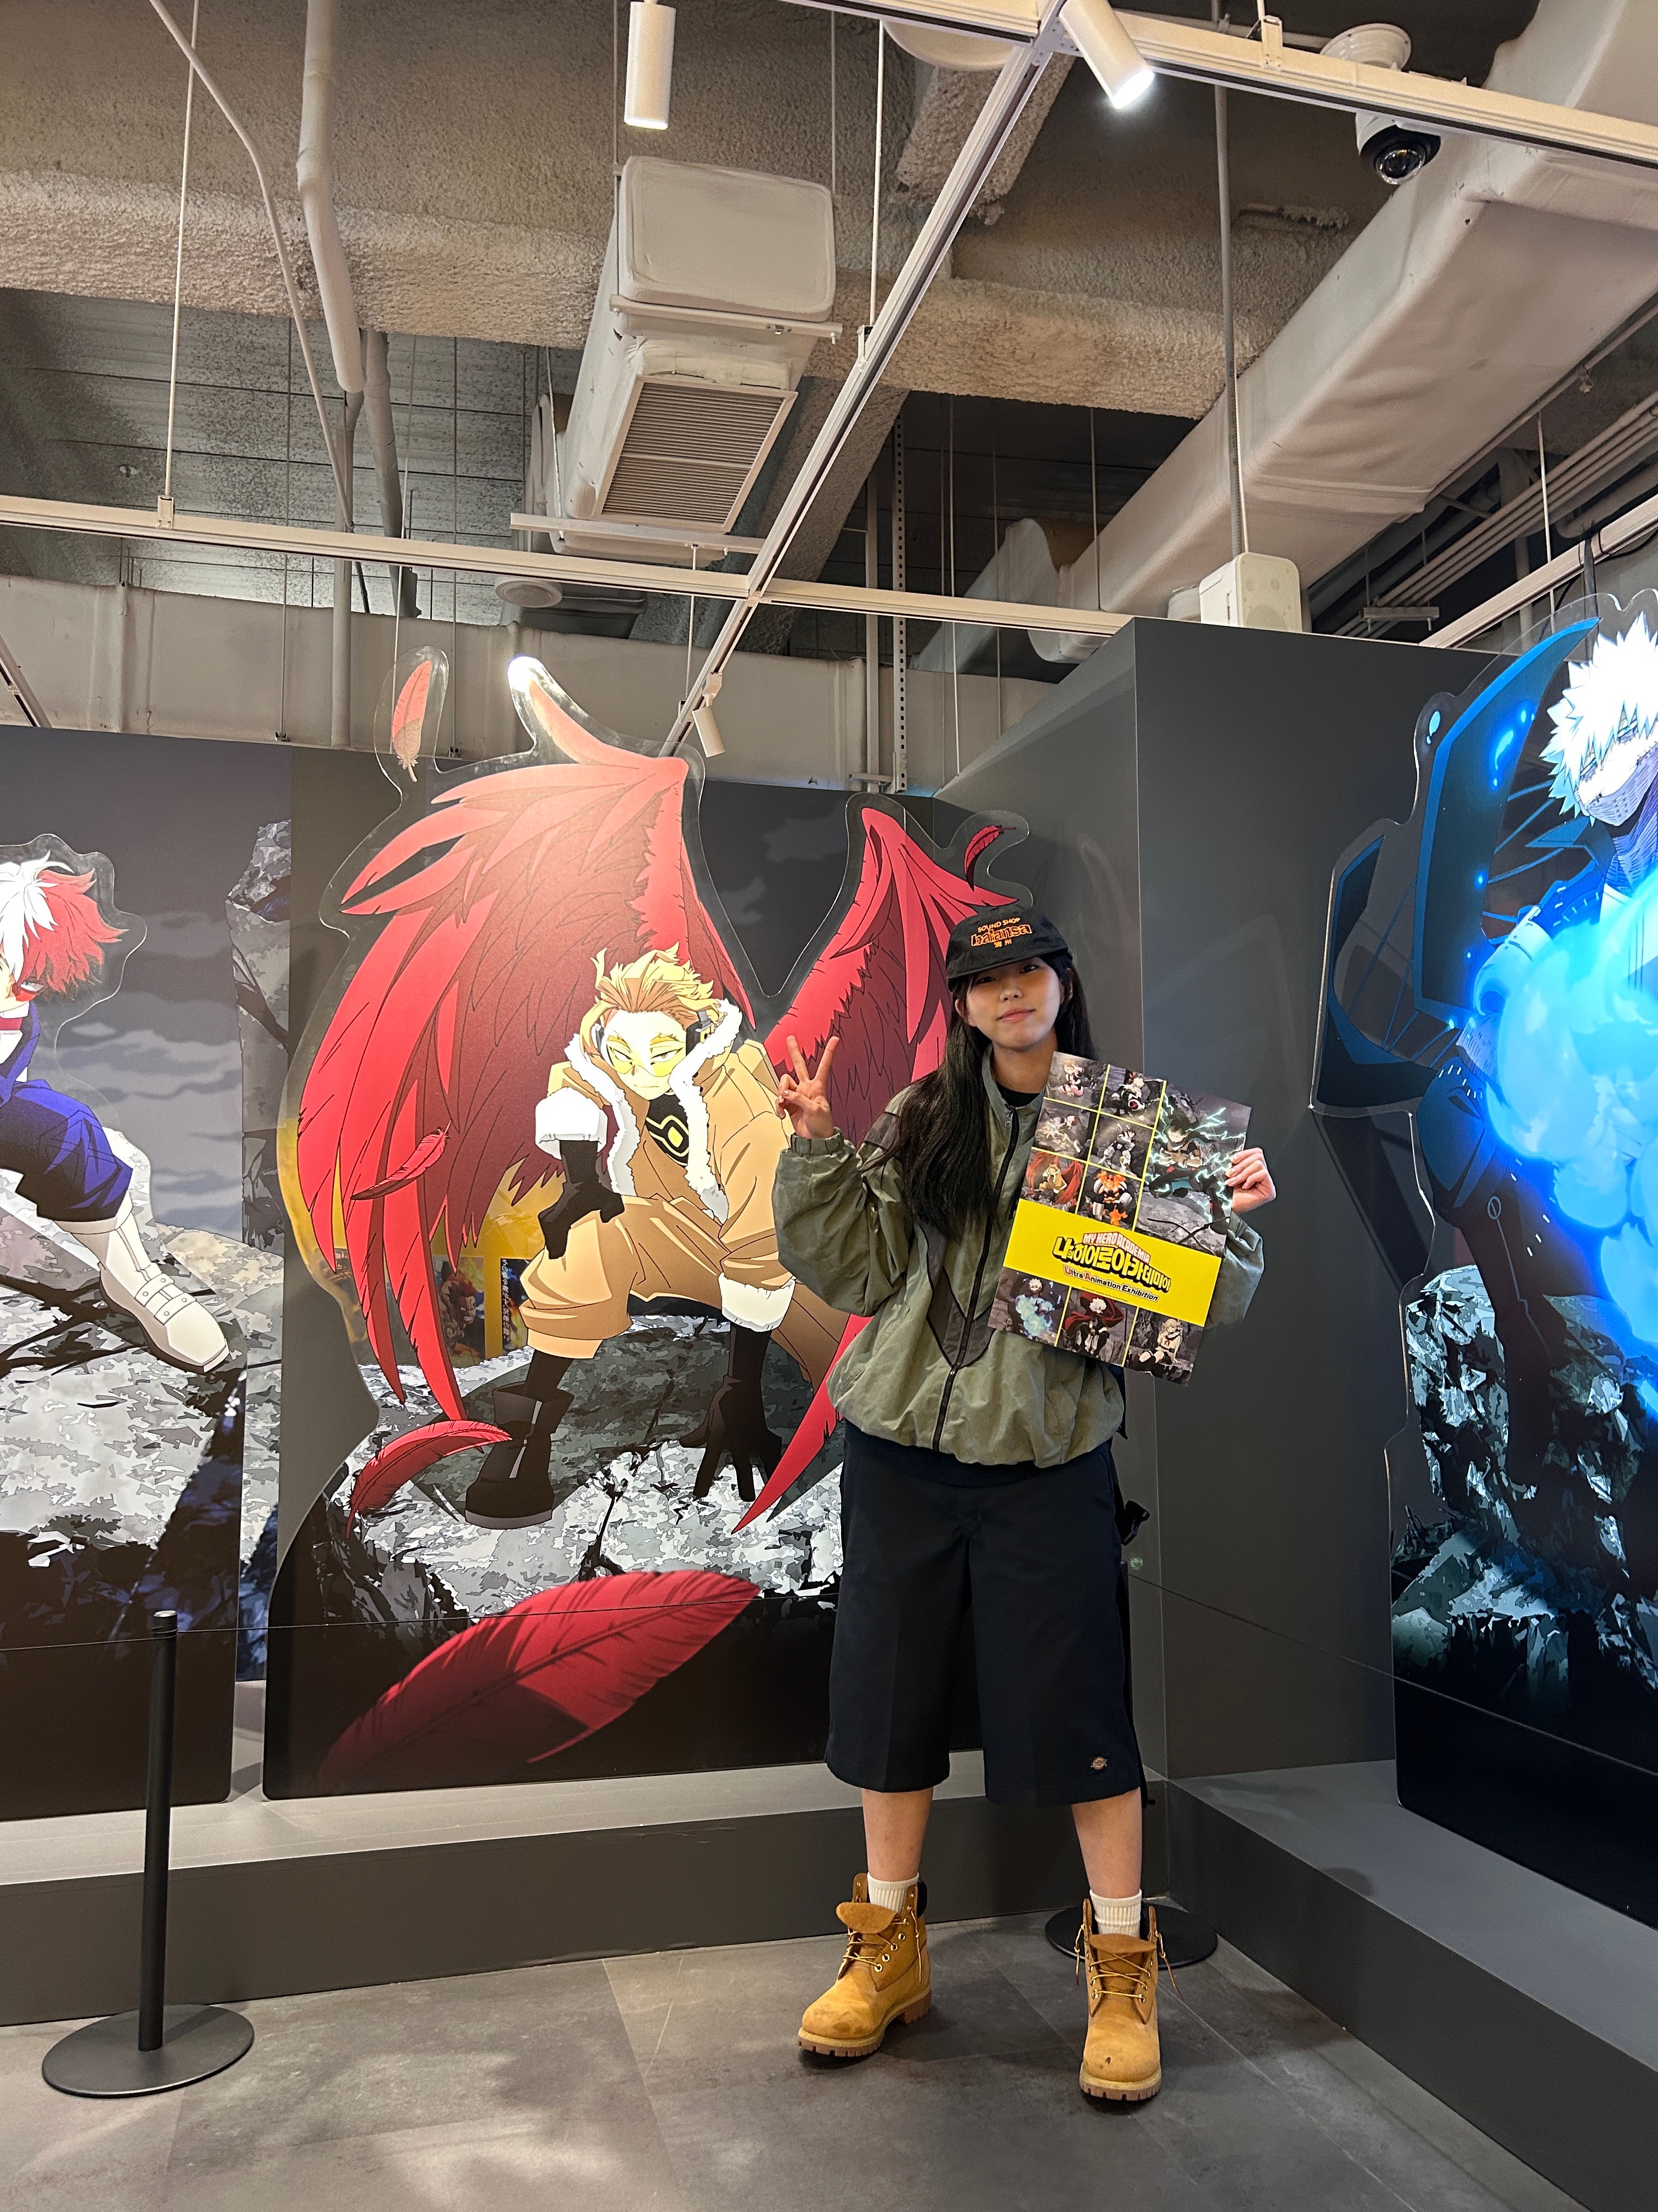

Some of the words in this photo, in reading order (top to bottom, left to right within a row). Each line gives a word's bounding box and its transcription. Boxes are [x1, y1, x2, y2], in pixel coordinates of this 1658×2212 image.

[971, 924, 1033, 946] balansa
[978, 922, 1002, 933] SOUND
[1002, 917, 1020, 926] SHOP
[1083, 1233, 1097, 1244] MY
[1096, 1232, 1118, 1245] HERO
[1116, 1233, 1151, 1264] ACADEMIA
[1063, 1266, 1084, 1279] Ultra
[1085, 1272, 1121, 1290] Animation
[1121, 1284, 1158, 1301] Exhibition
